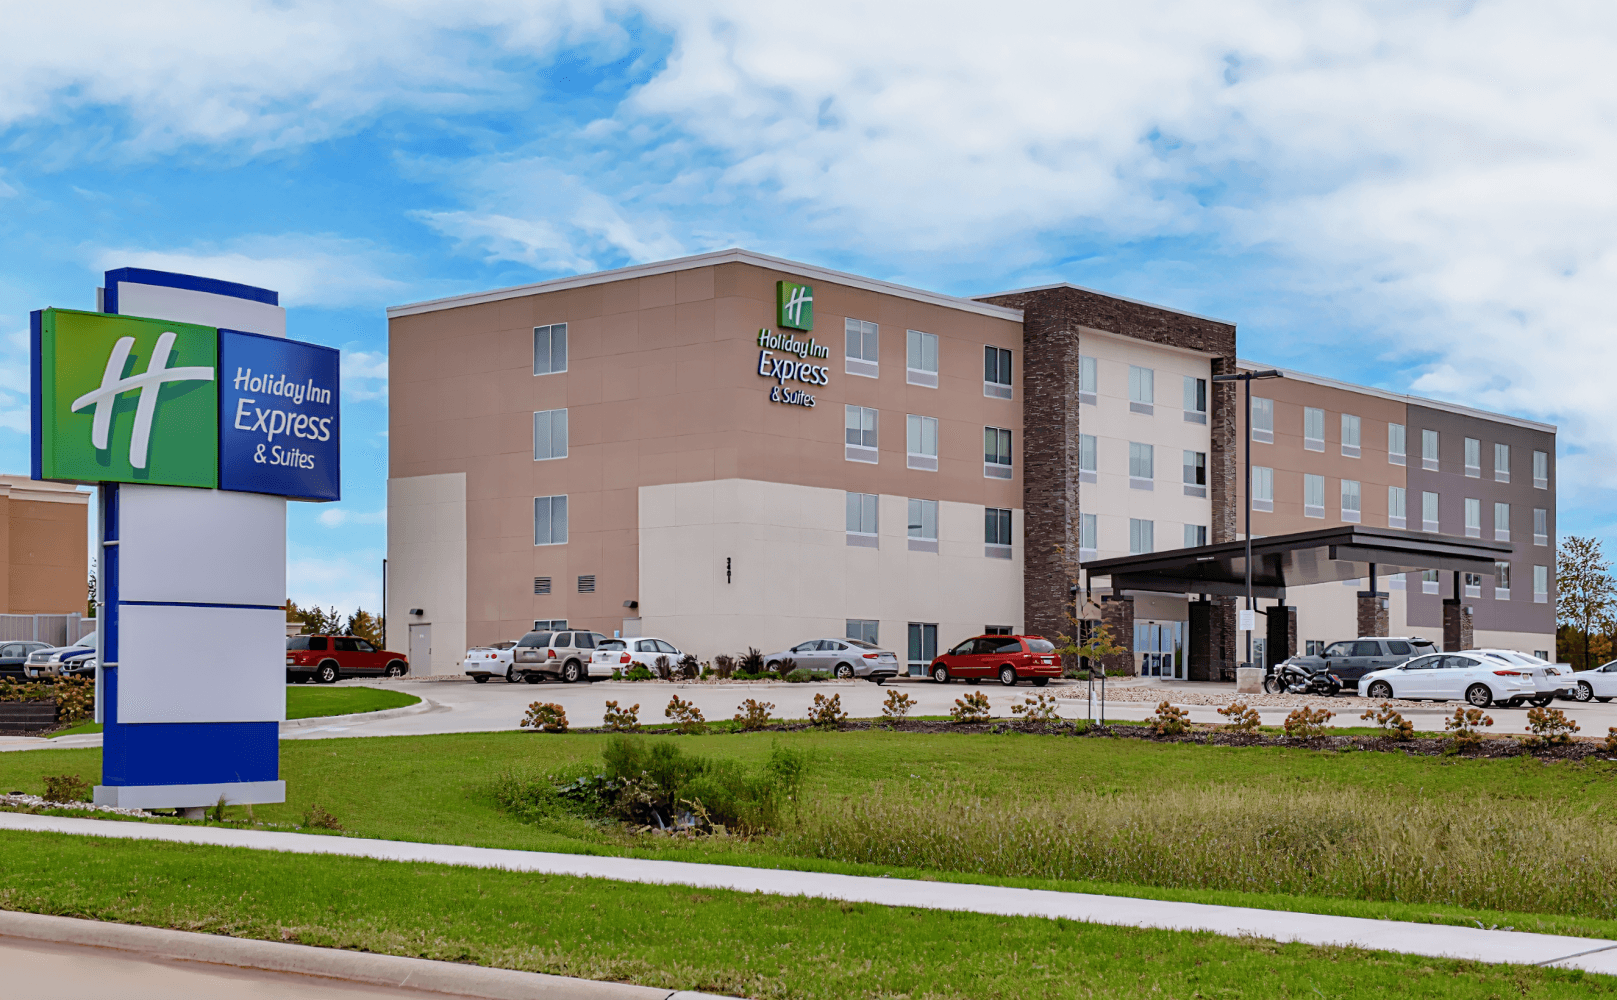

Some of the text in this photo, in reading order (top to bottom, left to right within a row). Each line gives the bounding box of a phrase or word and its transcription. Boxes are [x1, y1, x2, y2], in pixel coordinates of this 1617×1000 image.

[785, 286, 813, 326] H
[759, 328, 829, 359] Holiday Inn
[233, 366, 331, 405] Holiday Inn
[759, 349, 829, 386] Express
[71, 331, 215, 469] H
[771, 386, 816, 407] & Suites
[234, 397, 331, 442] Express
[253, 443, 315, 470] & Suites
